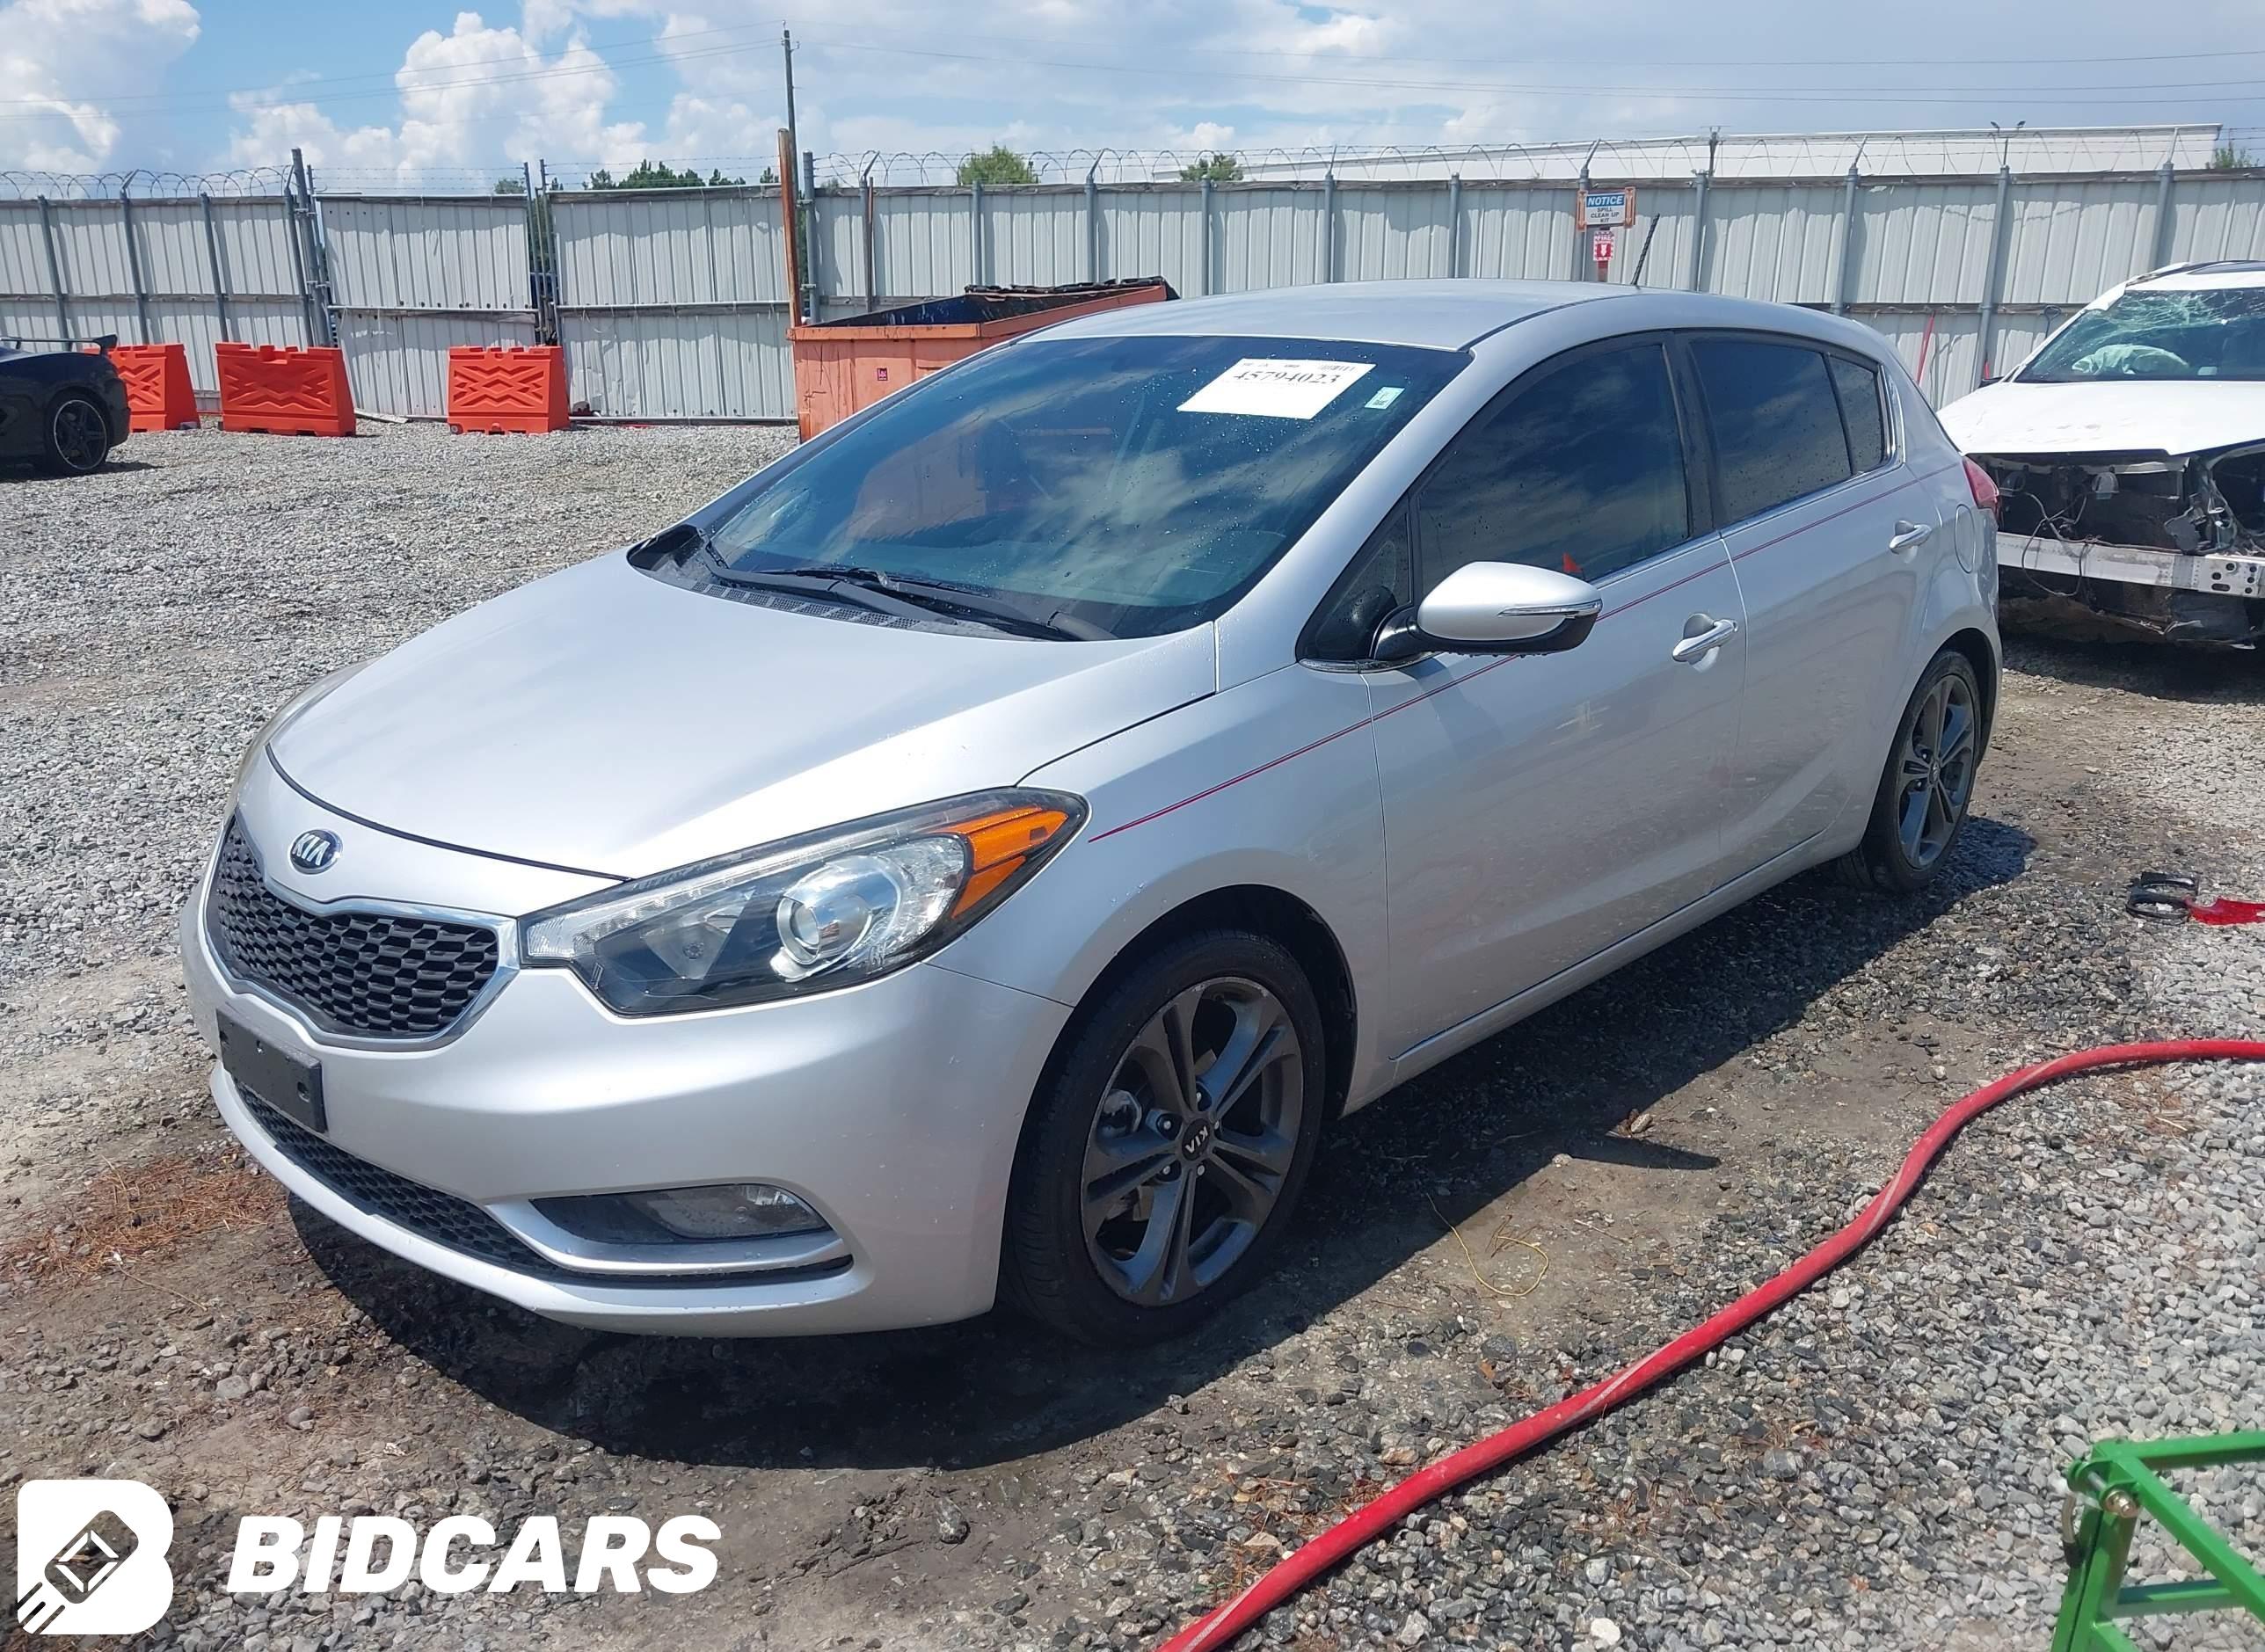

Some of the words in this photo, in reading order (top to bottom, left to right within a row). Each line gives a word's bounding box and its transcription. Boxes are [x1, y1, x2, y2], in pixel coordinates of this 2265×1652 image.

[1588, 196, 1623, 206] NOTICE
[1234, 371, 1341, 384] 45794023
[292, 833, 331, 866] KIA
[1184, 1125, 1209, 1153] KIA
